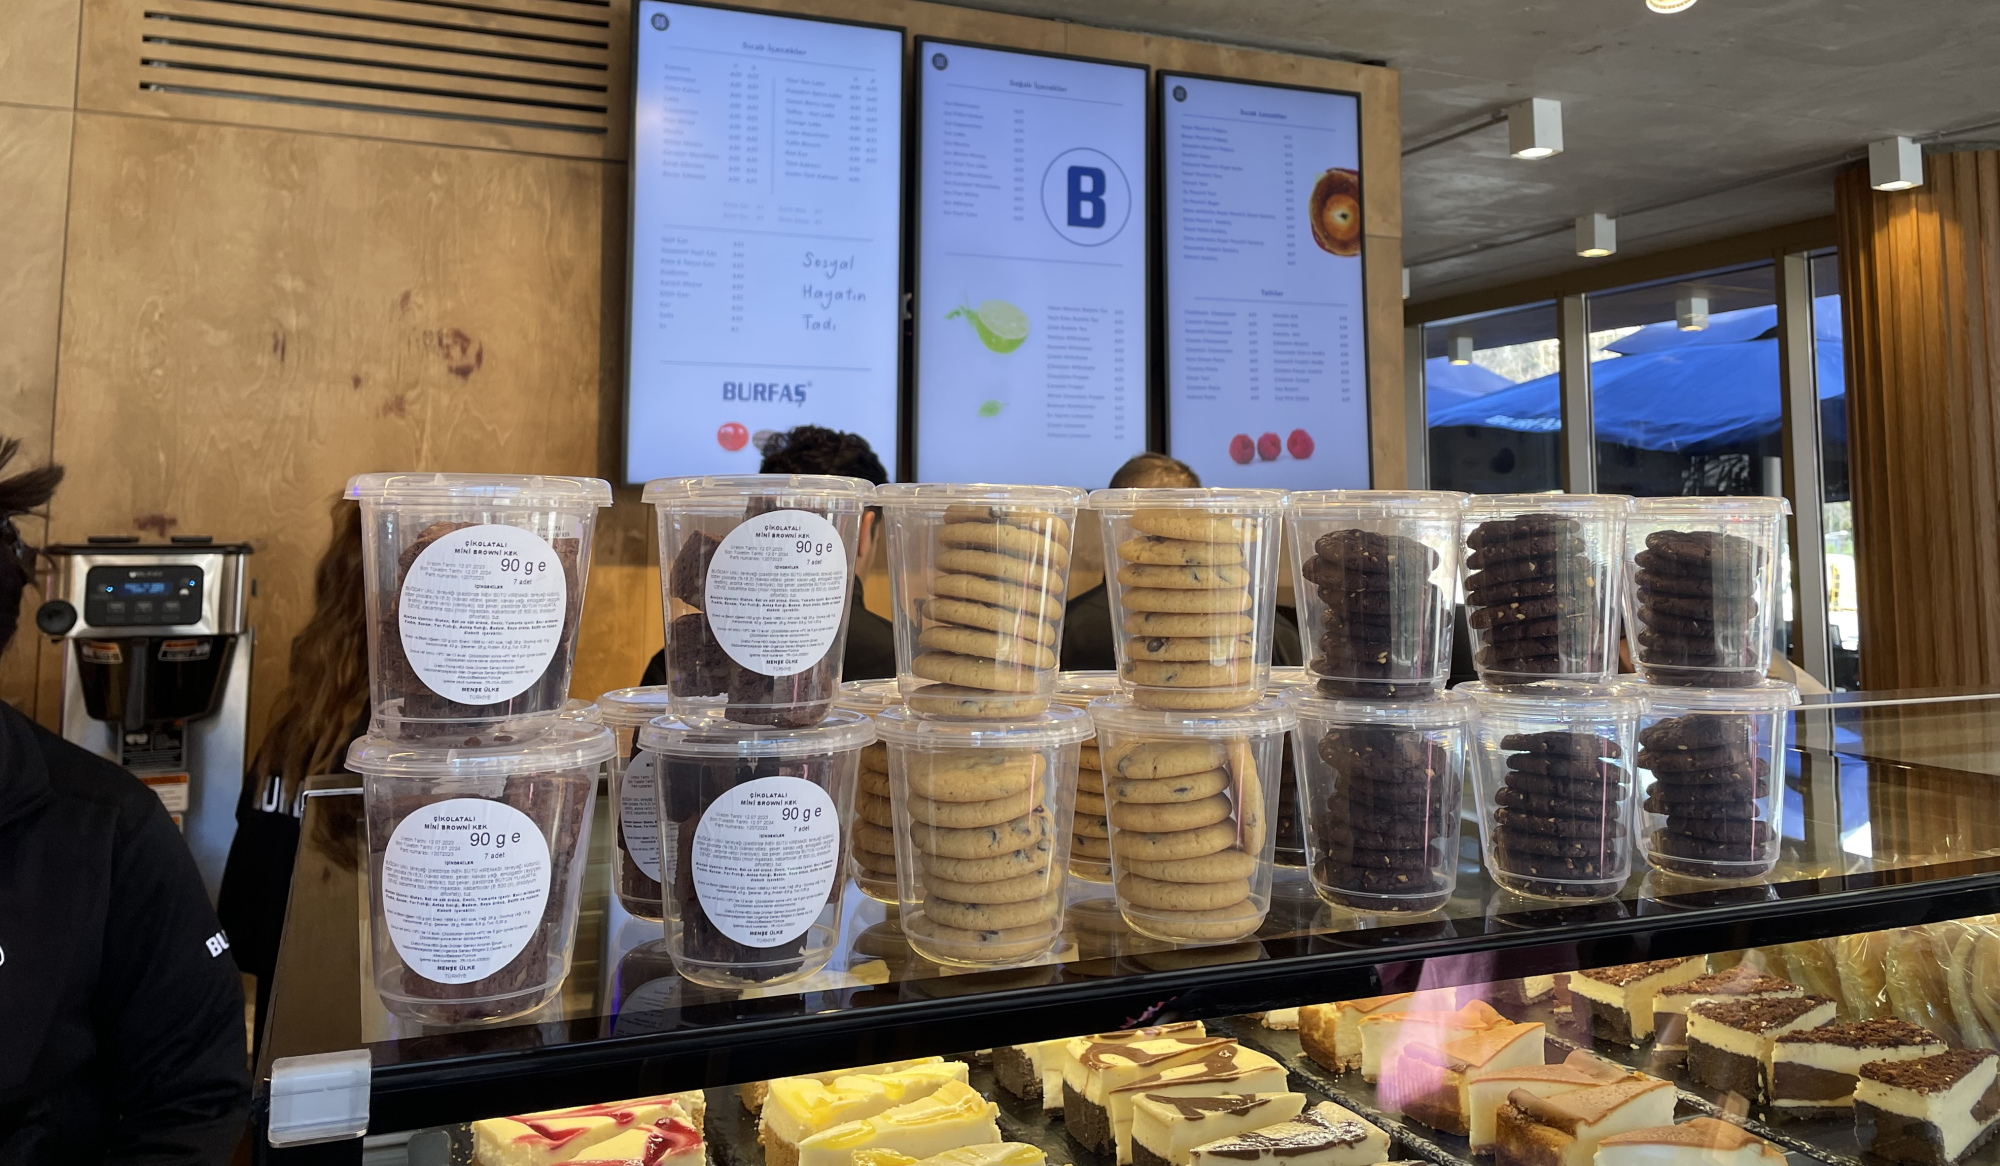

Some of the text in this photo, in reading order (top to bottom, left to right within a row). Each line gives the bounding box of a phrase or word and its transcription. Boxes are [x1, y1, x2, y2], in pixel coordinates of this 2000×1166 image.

[1067, 165, 1106, 229] B
[802, 251, 854, 279] Sosyal
[802, 284, 866, 310] Hayatın
[802, 313, 836, 332] Tadı
[722, 381, 808, 408] BURFAŞ
[465, 540, 507, 548] ÇİKOLATALI
[796, 540, 833, 556] 90 g e
[501, 558, 546, 576] 90 g e
[433, 815, 476, 823] ÇİKOLATALI
[782, 807, 822, 822] 90 g e
[441, 823, 471, 831] BROWNİ
[470, 832, 521, 849] 90 g e
[490, 851, 505, 859] adet
